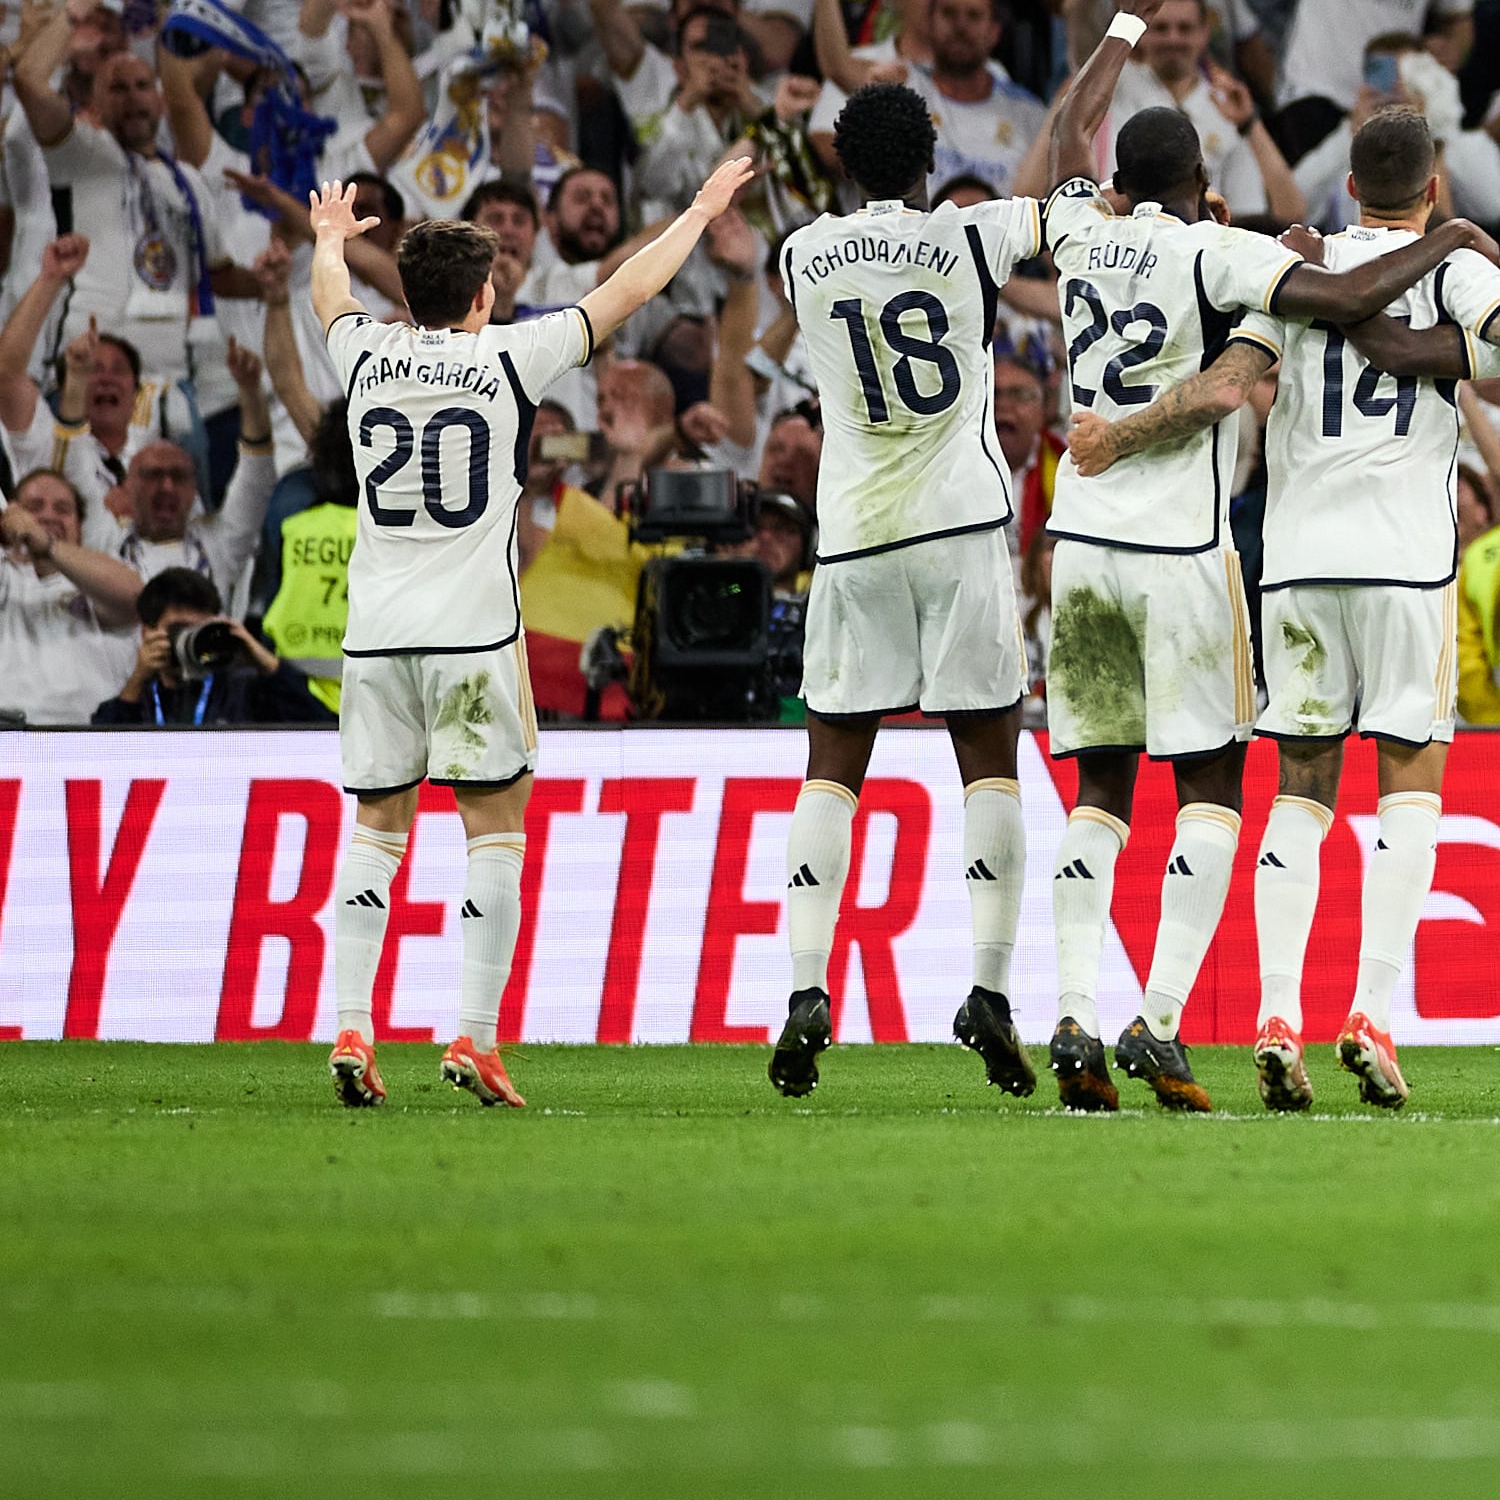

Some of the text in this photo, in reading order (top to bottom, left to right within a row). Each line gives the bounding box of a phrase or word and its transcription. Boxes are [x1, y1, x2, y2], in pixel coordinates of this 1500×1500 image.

[359, 356, 500, 403] FRAN GARCÍA
[830, 290, 961, 425] 18
[1065, 278, 1168, 408] 22
[1311, 317, 1417, 438] 14
[359, 406, 490, 529] 20
[214, 778, 934, 1043] BETTER
